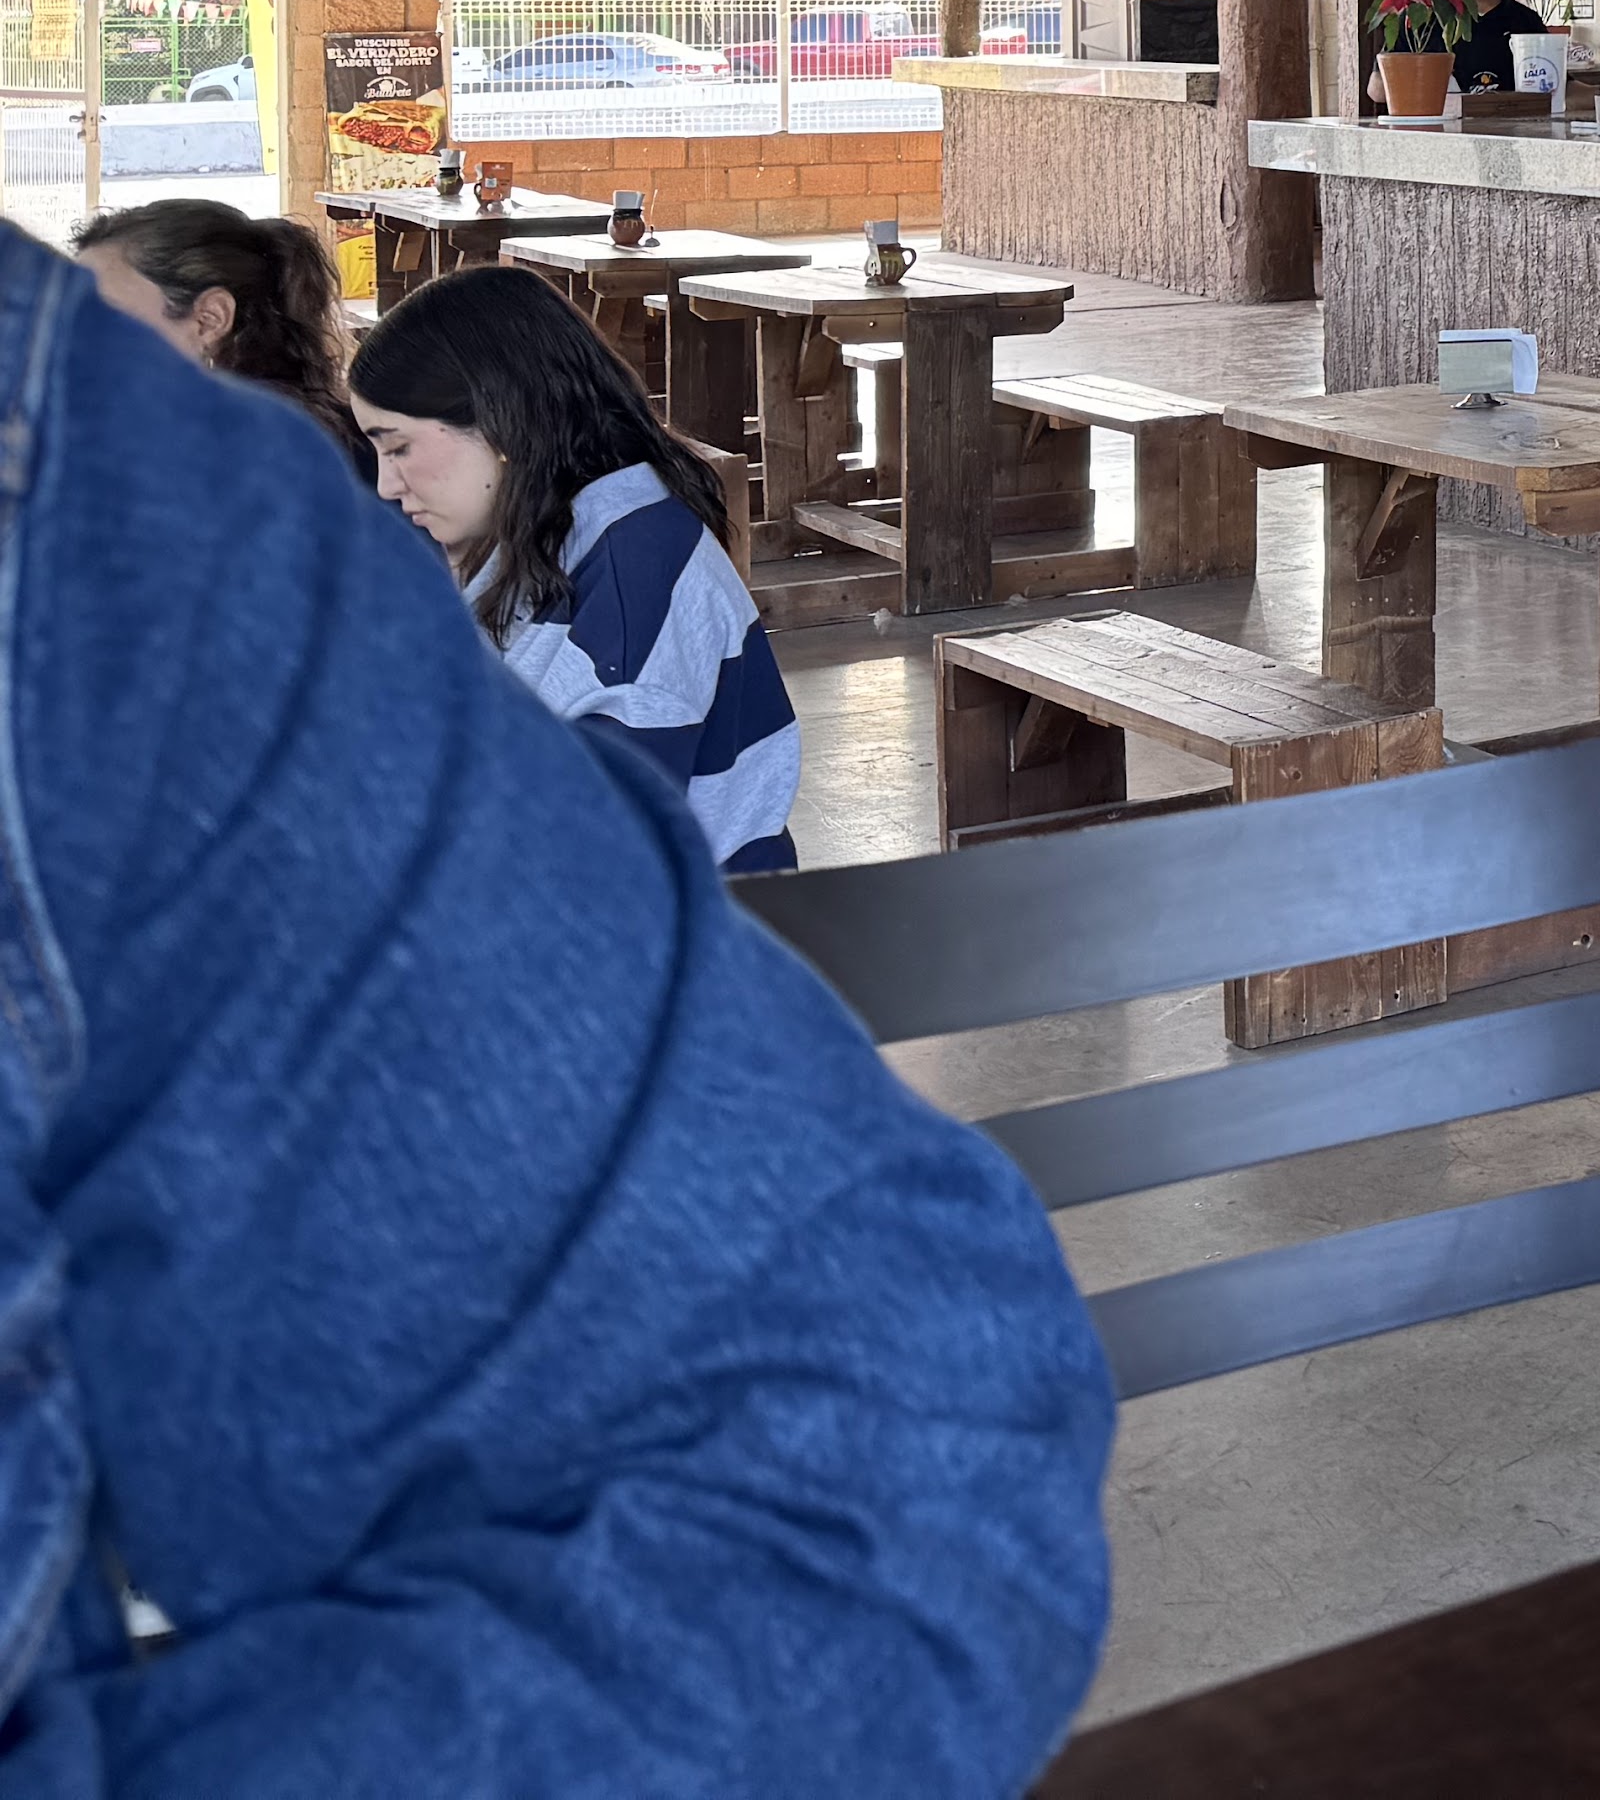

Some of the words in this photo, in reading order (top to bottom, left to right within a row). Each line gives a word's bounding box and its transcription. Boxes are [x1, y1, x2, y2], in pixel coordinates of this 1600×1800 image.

[354, 39, 410, 47] DESCUBRE
[327, 48, 346, 60] EL
[348, 46, 439, 59] VERDADERO
[336, 59, 372, 68] SABOR
[373, 58, 394, 67] DEL
[395, 57, 431, 66] NORTE
[376, 67, 391, 76] EN
